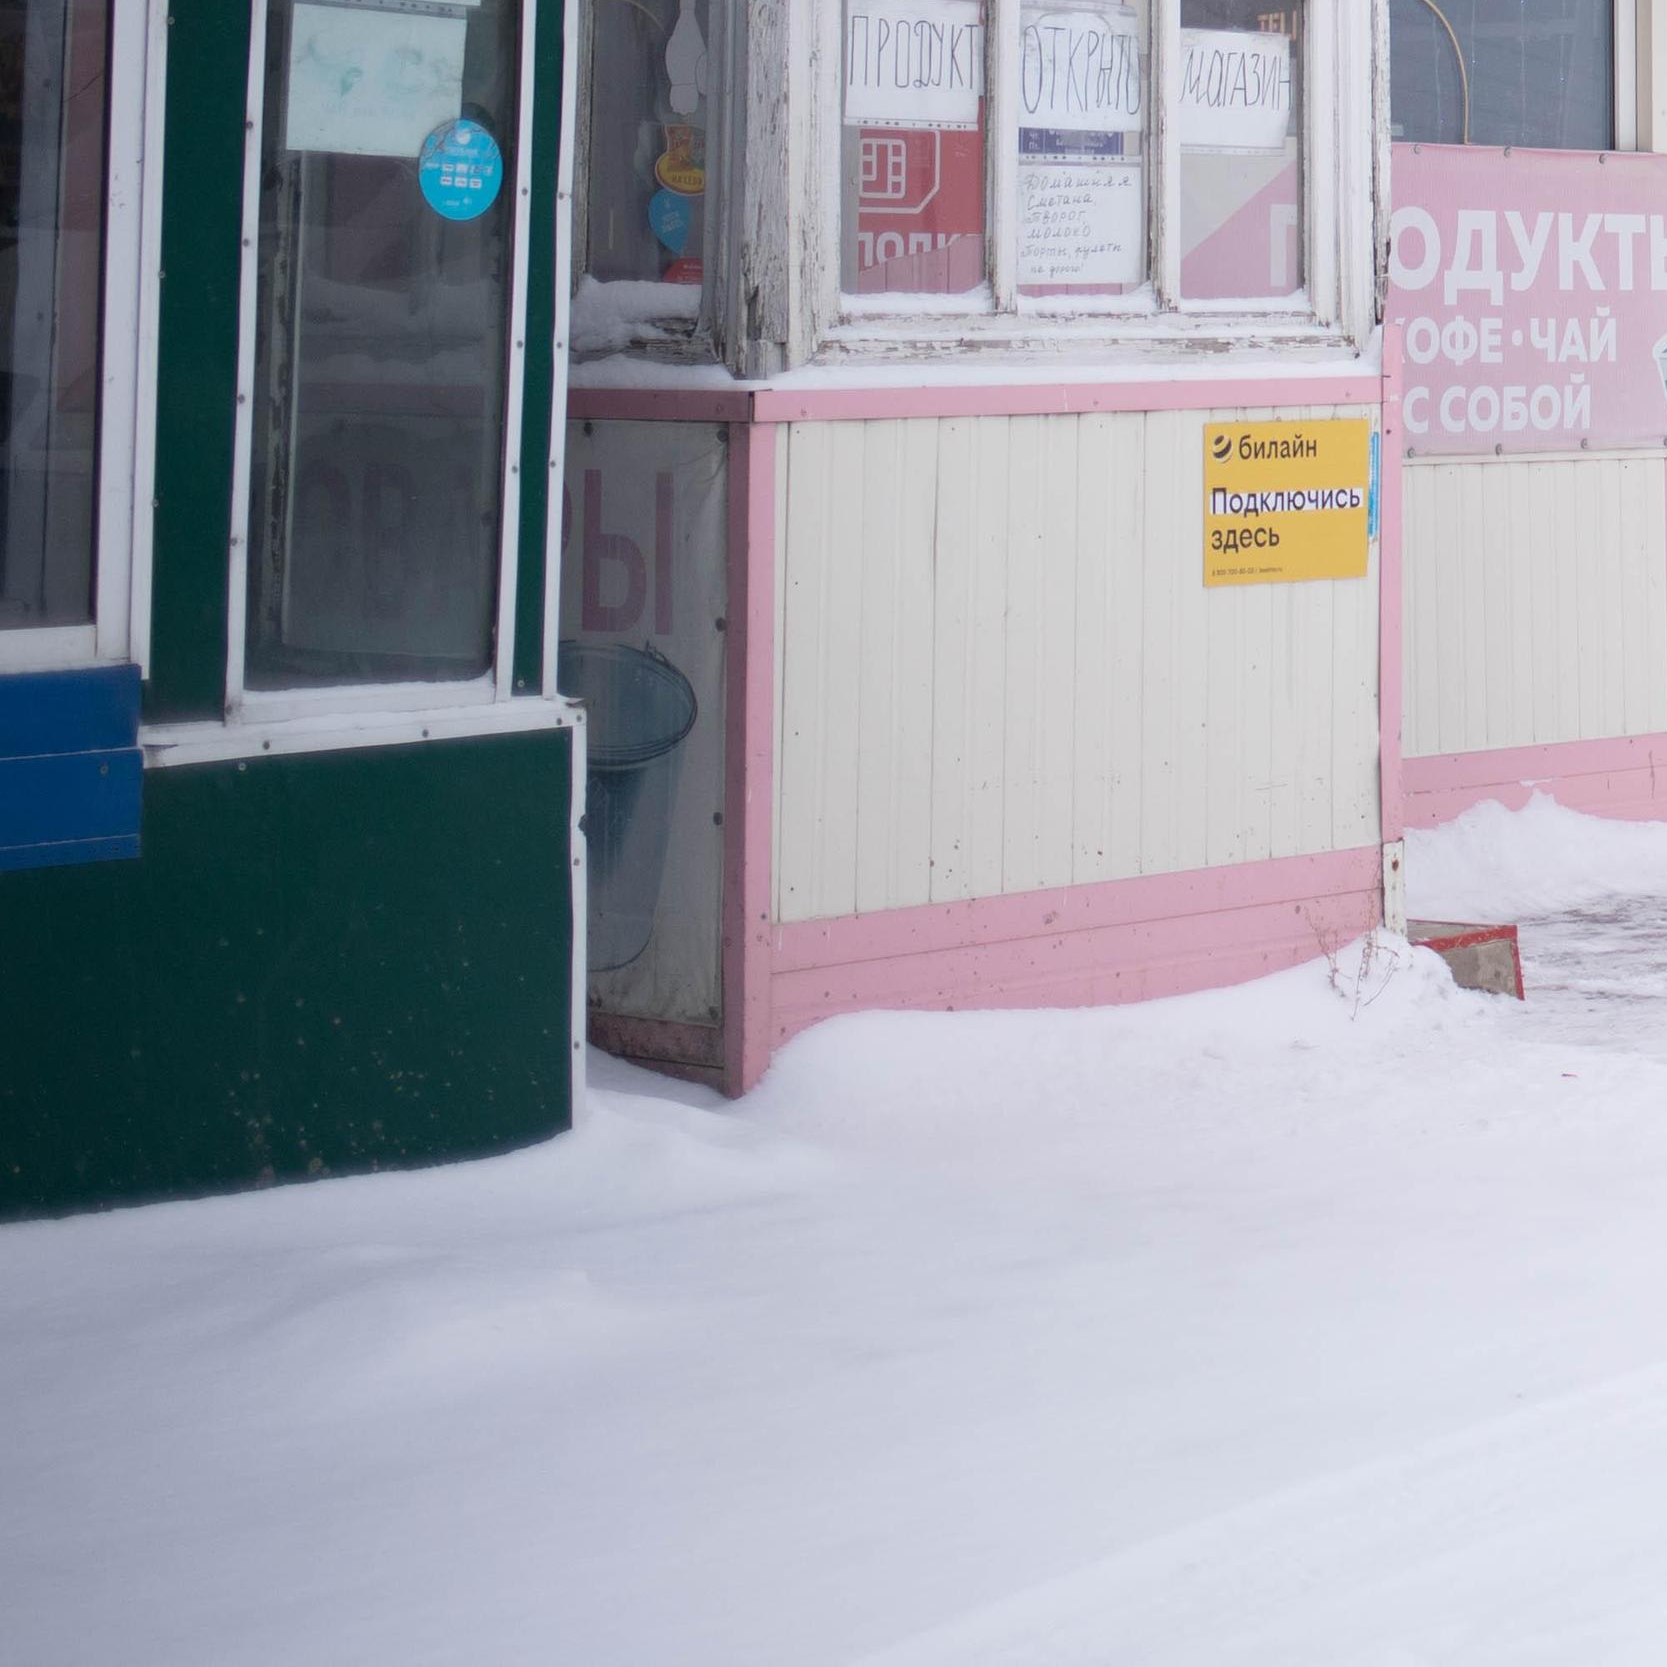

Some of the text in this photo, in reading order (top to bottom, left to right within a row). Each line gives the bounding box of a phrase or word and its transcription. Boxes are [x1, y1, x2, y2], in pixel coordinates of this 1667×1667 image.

[850, 15, 979, 89] ПРОДУКТ
[1396, 306, 1617, 365] ОФЕ ЧАЙ
[1403, 372, 1591, 434] С СОБОЙ
[1239, 434, 1317, 460] билайн
[1212, 487, 1361, 518] Подключись
[1211, 527, 1280, 554] здесь
